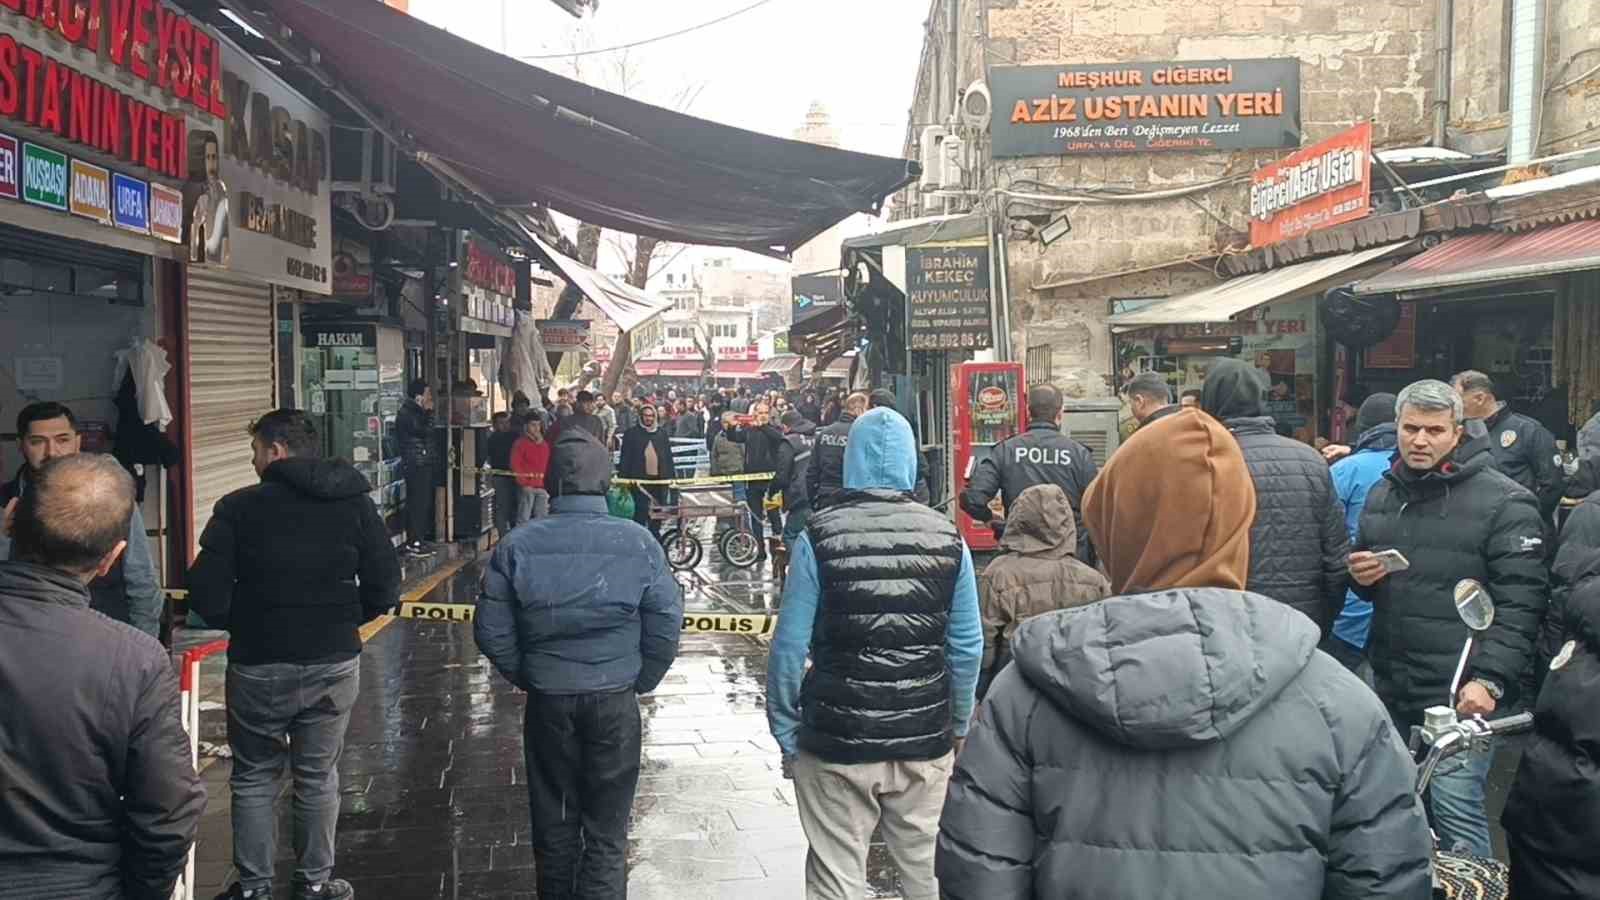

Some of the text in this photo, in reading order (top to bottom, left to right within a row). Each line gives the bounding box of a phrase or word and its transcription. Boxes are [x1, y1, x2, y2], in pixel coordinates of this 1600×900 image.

[110, 0, 224, 120] VEYSEL
[1058, 64, 1233, 91] MEŞHUR CİĞERCİ
[1010, 88, 1283, 123] AZİZ USTANIN YERİ
[1053, 122, 1240, 140] 1968'den Beri Değişmeyen Lezzet
[1321, 149, 1355, 191] Usta
[117, 185, 144, 220] URFA
[1015, 447, 1071, 466] POLIS
